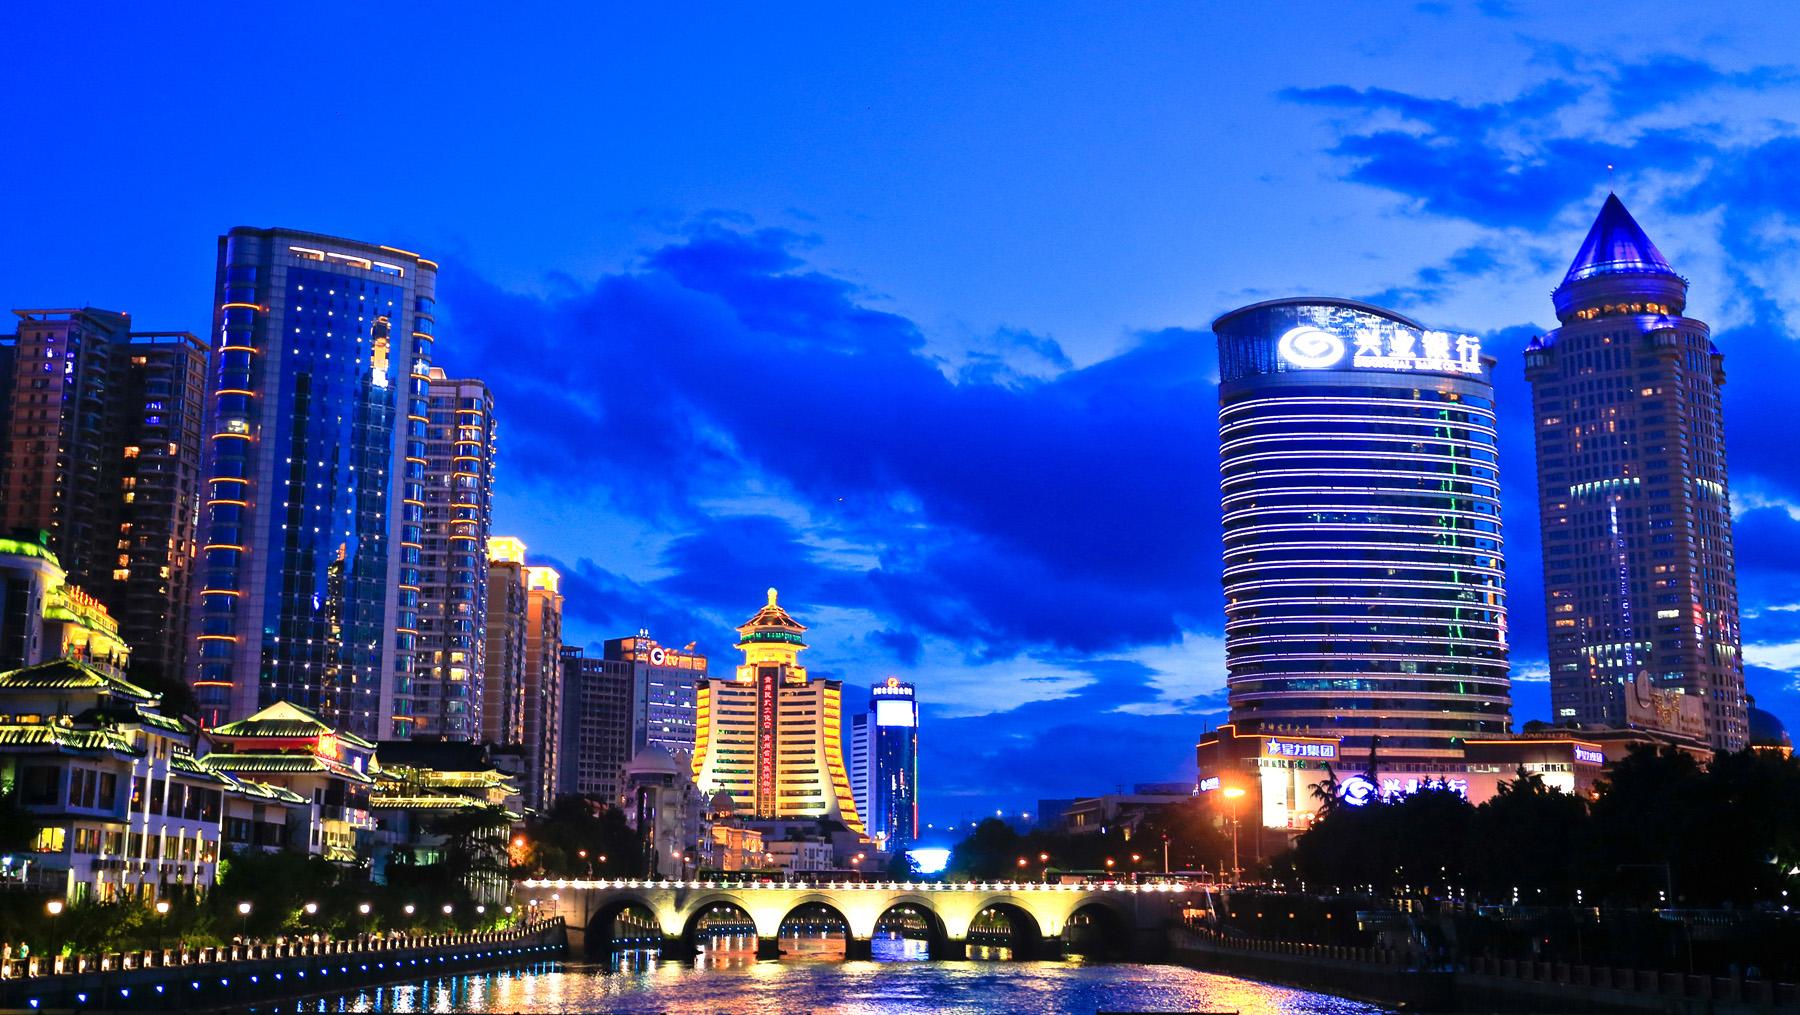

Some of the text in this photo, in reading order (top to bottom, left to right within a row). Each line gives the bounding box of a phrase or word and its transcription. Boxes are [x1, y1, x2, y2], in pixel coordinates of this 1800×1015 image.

[1282, 743, 1334, 757] 星力集团
[1382, 778, 1468, 801] 兴业行
